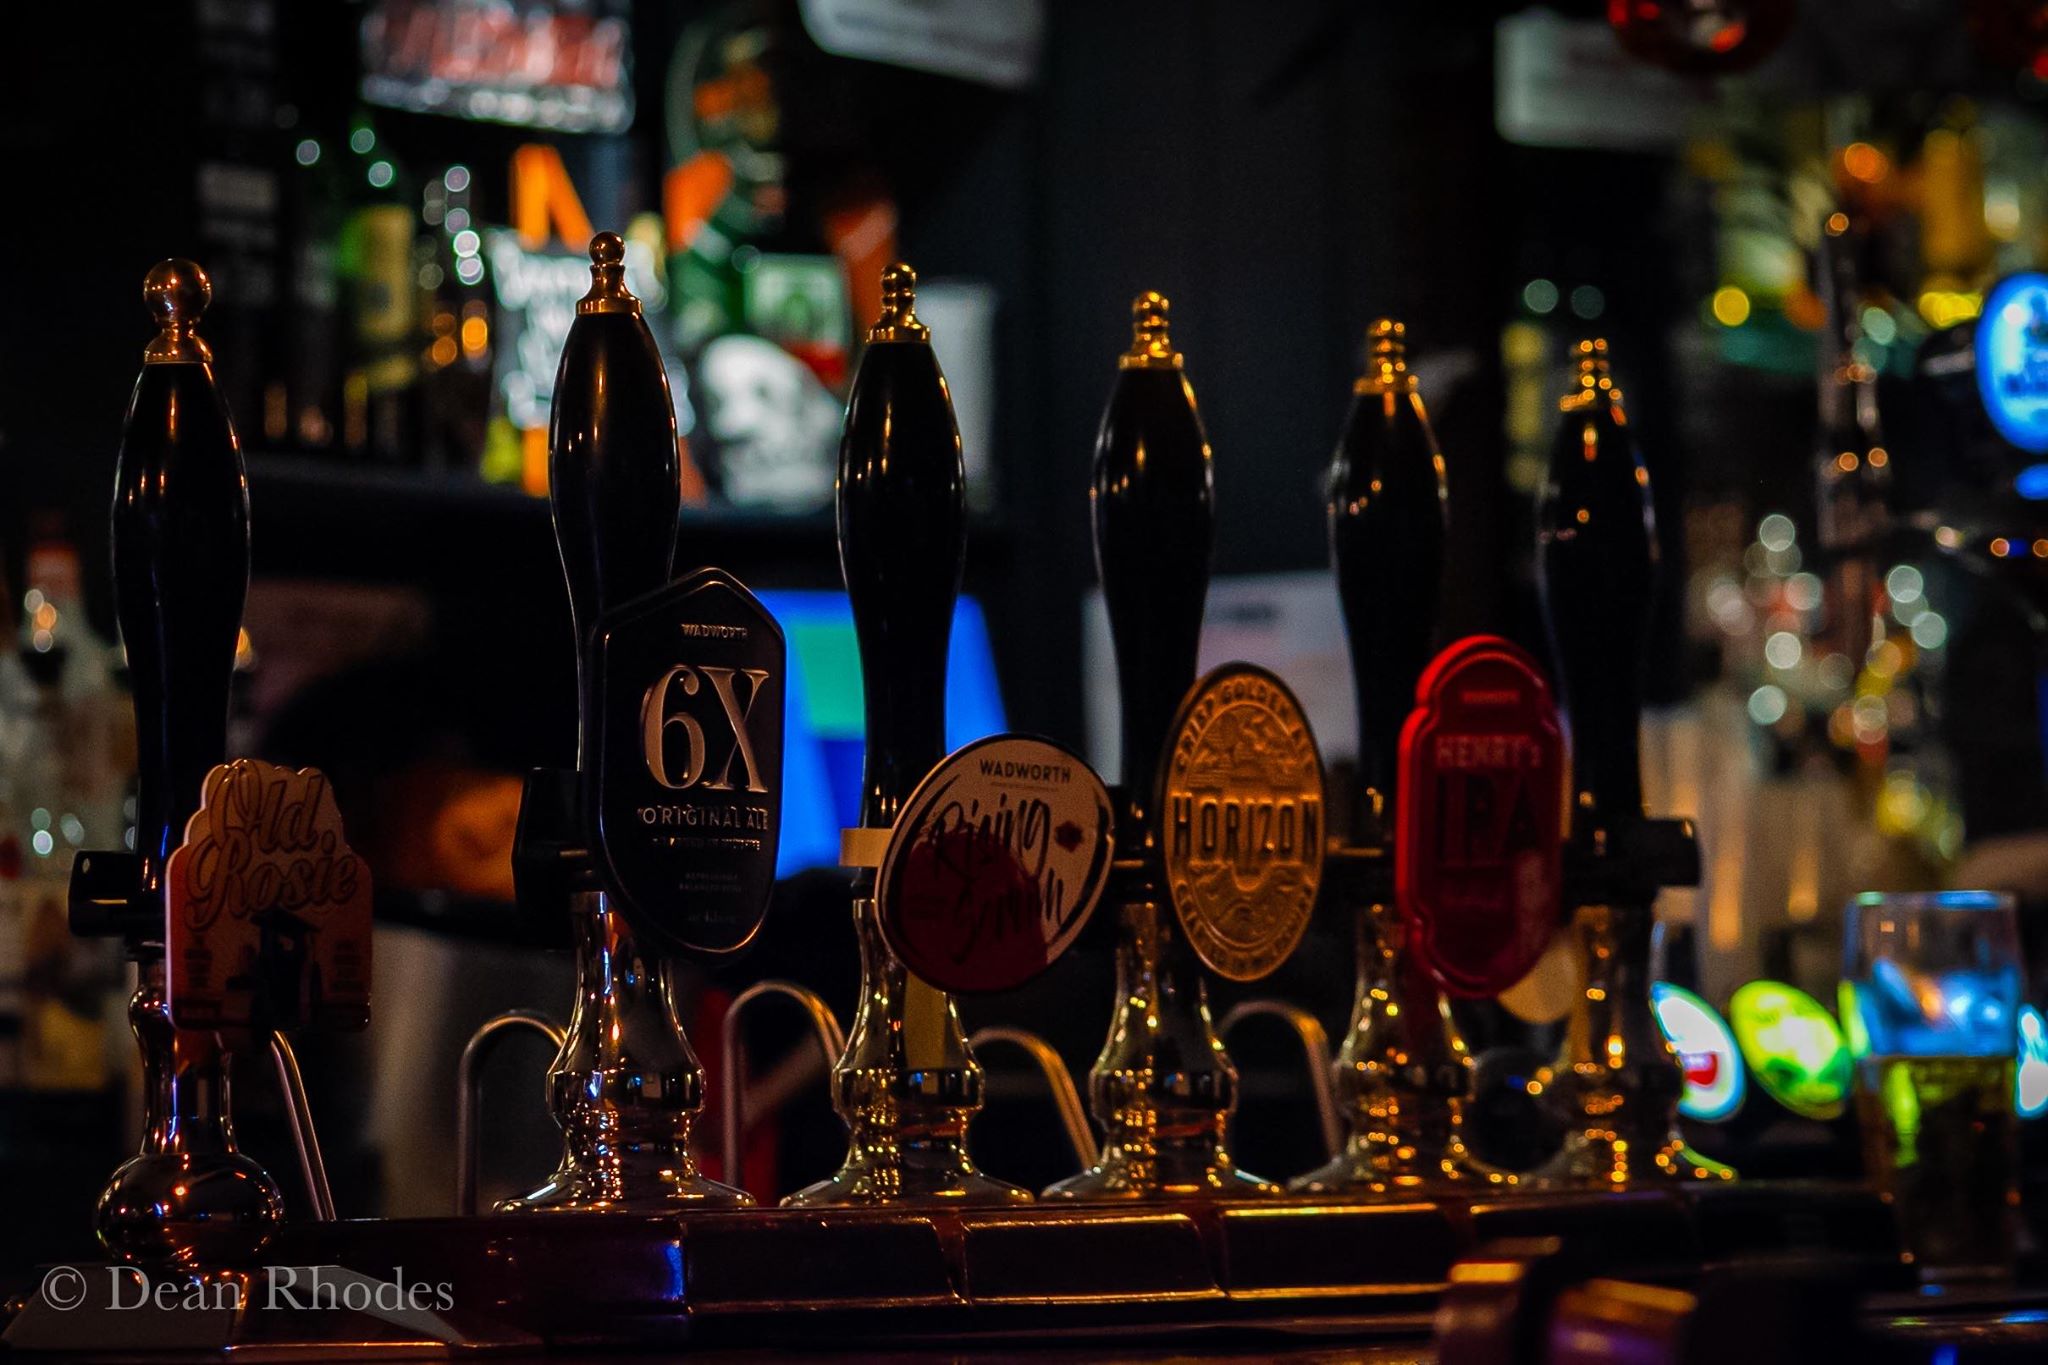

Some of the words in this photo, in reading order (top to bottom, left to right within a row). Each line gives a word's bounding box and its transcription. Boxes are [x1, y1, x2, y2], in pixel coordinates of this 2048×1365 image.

[681, 623, 748, 639] WADWORTH
[1221, 678, 1290, 718] GOLDEN
[640, 665, 770, 793] 6X
[979, 758, 1072, 783] WADWORTH
[208, 761, 324, 853] Old
[642, 804, 741, 829] ORIGINAL
[745, 806, 769, 831] ALE
[1170, 791, 1320, 859] HORIZON
[184, 827, 358, 930] Rosie
